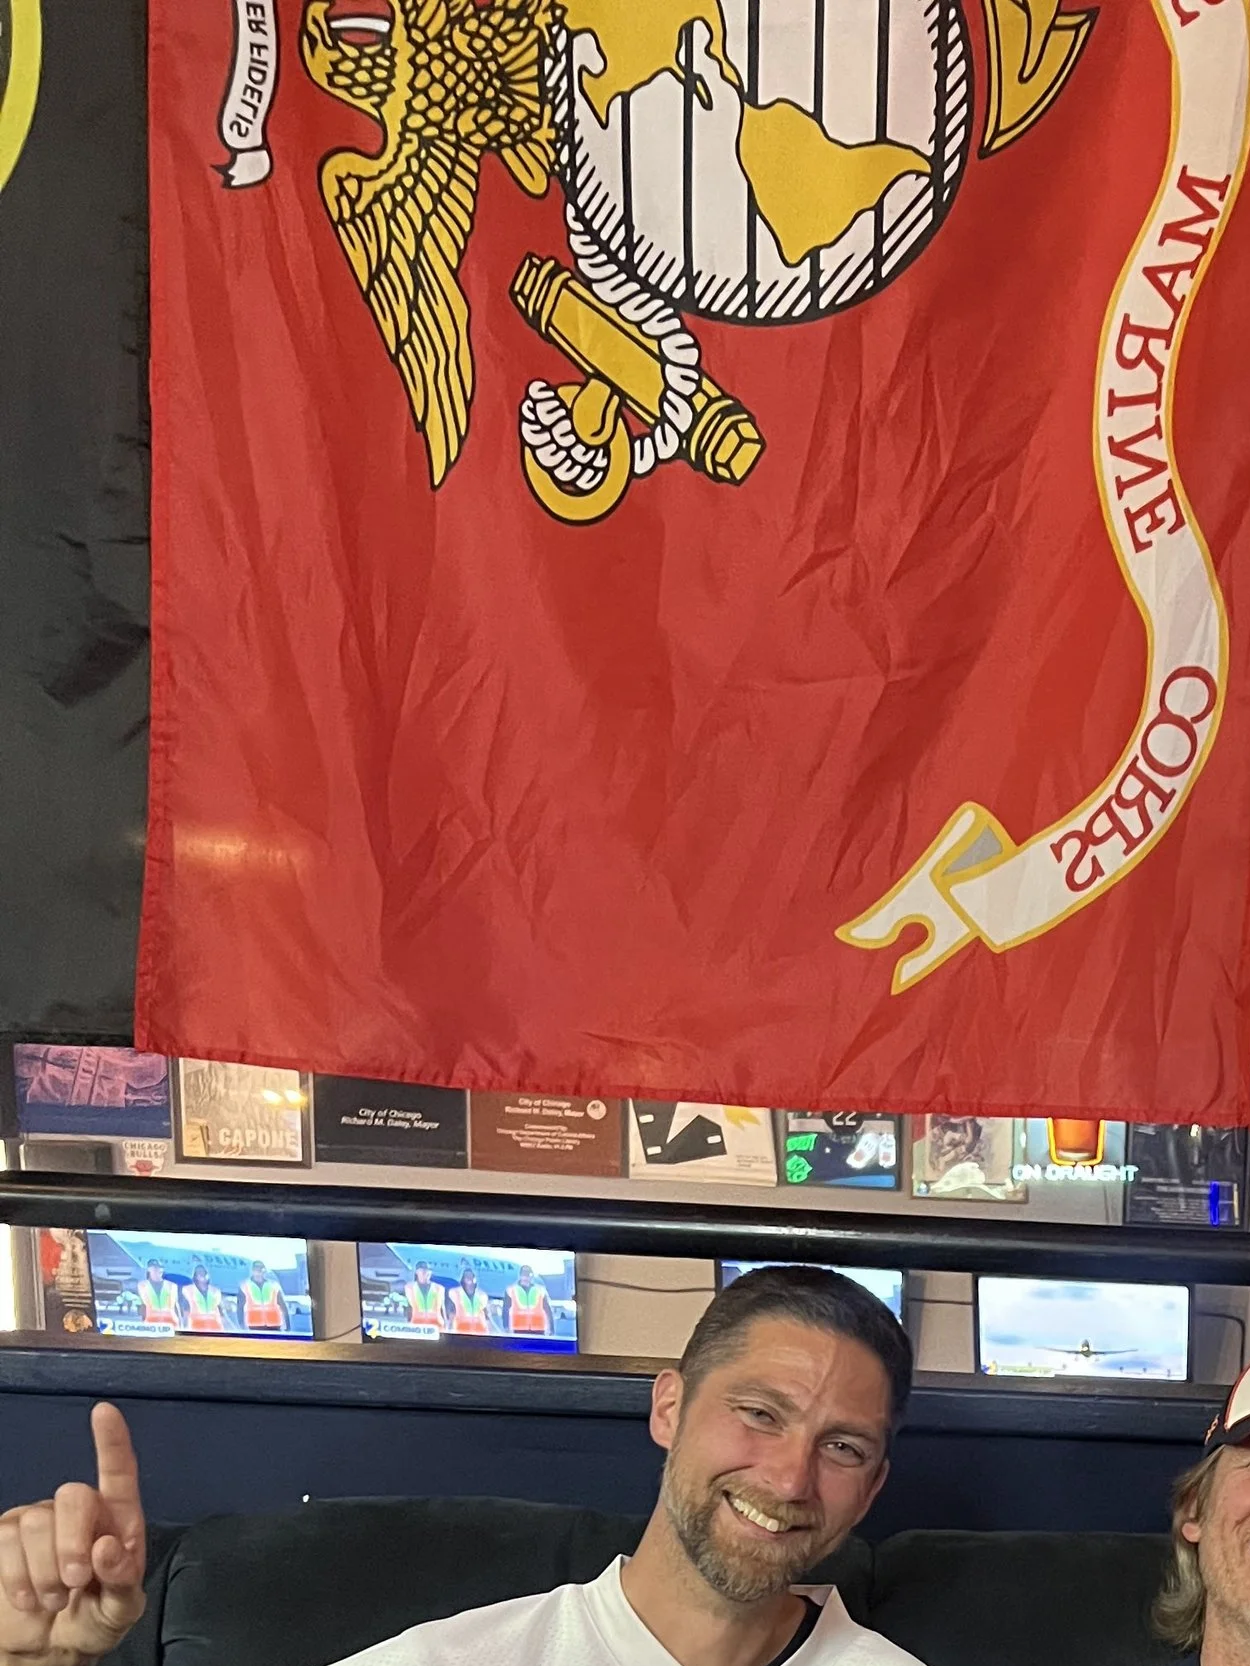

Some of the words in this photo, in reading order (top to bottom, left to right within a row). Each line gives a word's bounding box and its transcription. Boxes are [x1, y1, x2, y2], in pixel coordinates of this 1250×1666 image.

[377, 1109, 389, 1117] of
[123, 1142, 168, 1152] CHICAGO
[219, 1128, 298, 1151] CAPONE
[1012, 1164, 1043, 1181] ON
[1045, 1161, 1140, 1182] DRAUGHT
